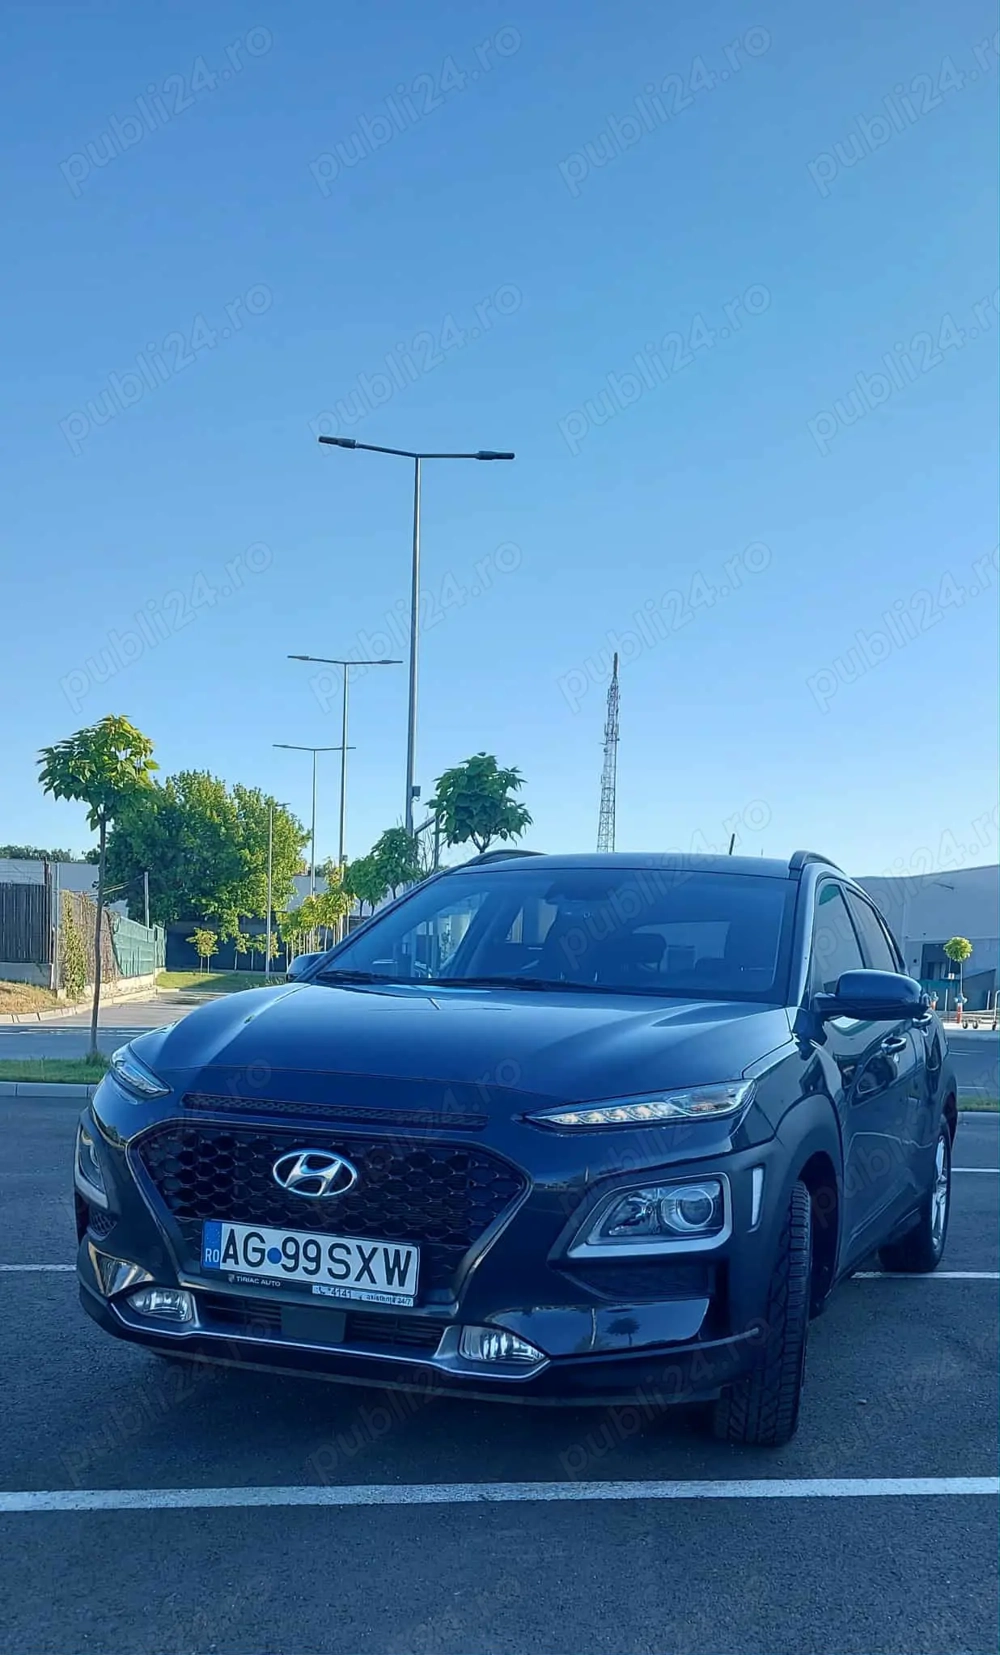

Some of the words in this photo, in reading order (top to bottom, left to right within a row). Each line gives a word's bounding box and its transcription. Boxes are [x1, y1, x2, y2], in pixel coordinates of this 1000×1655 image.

[205, 1248, 219, 1263] RO
[221, 1228, 266, 1268] AG
[261, 1279, 281, 1287] AUTO
